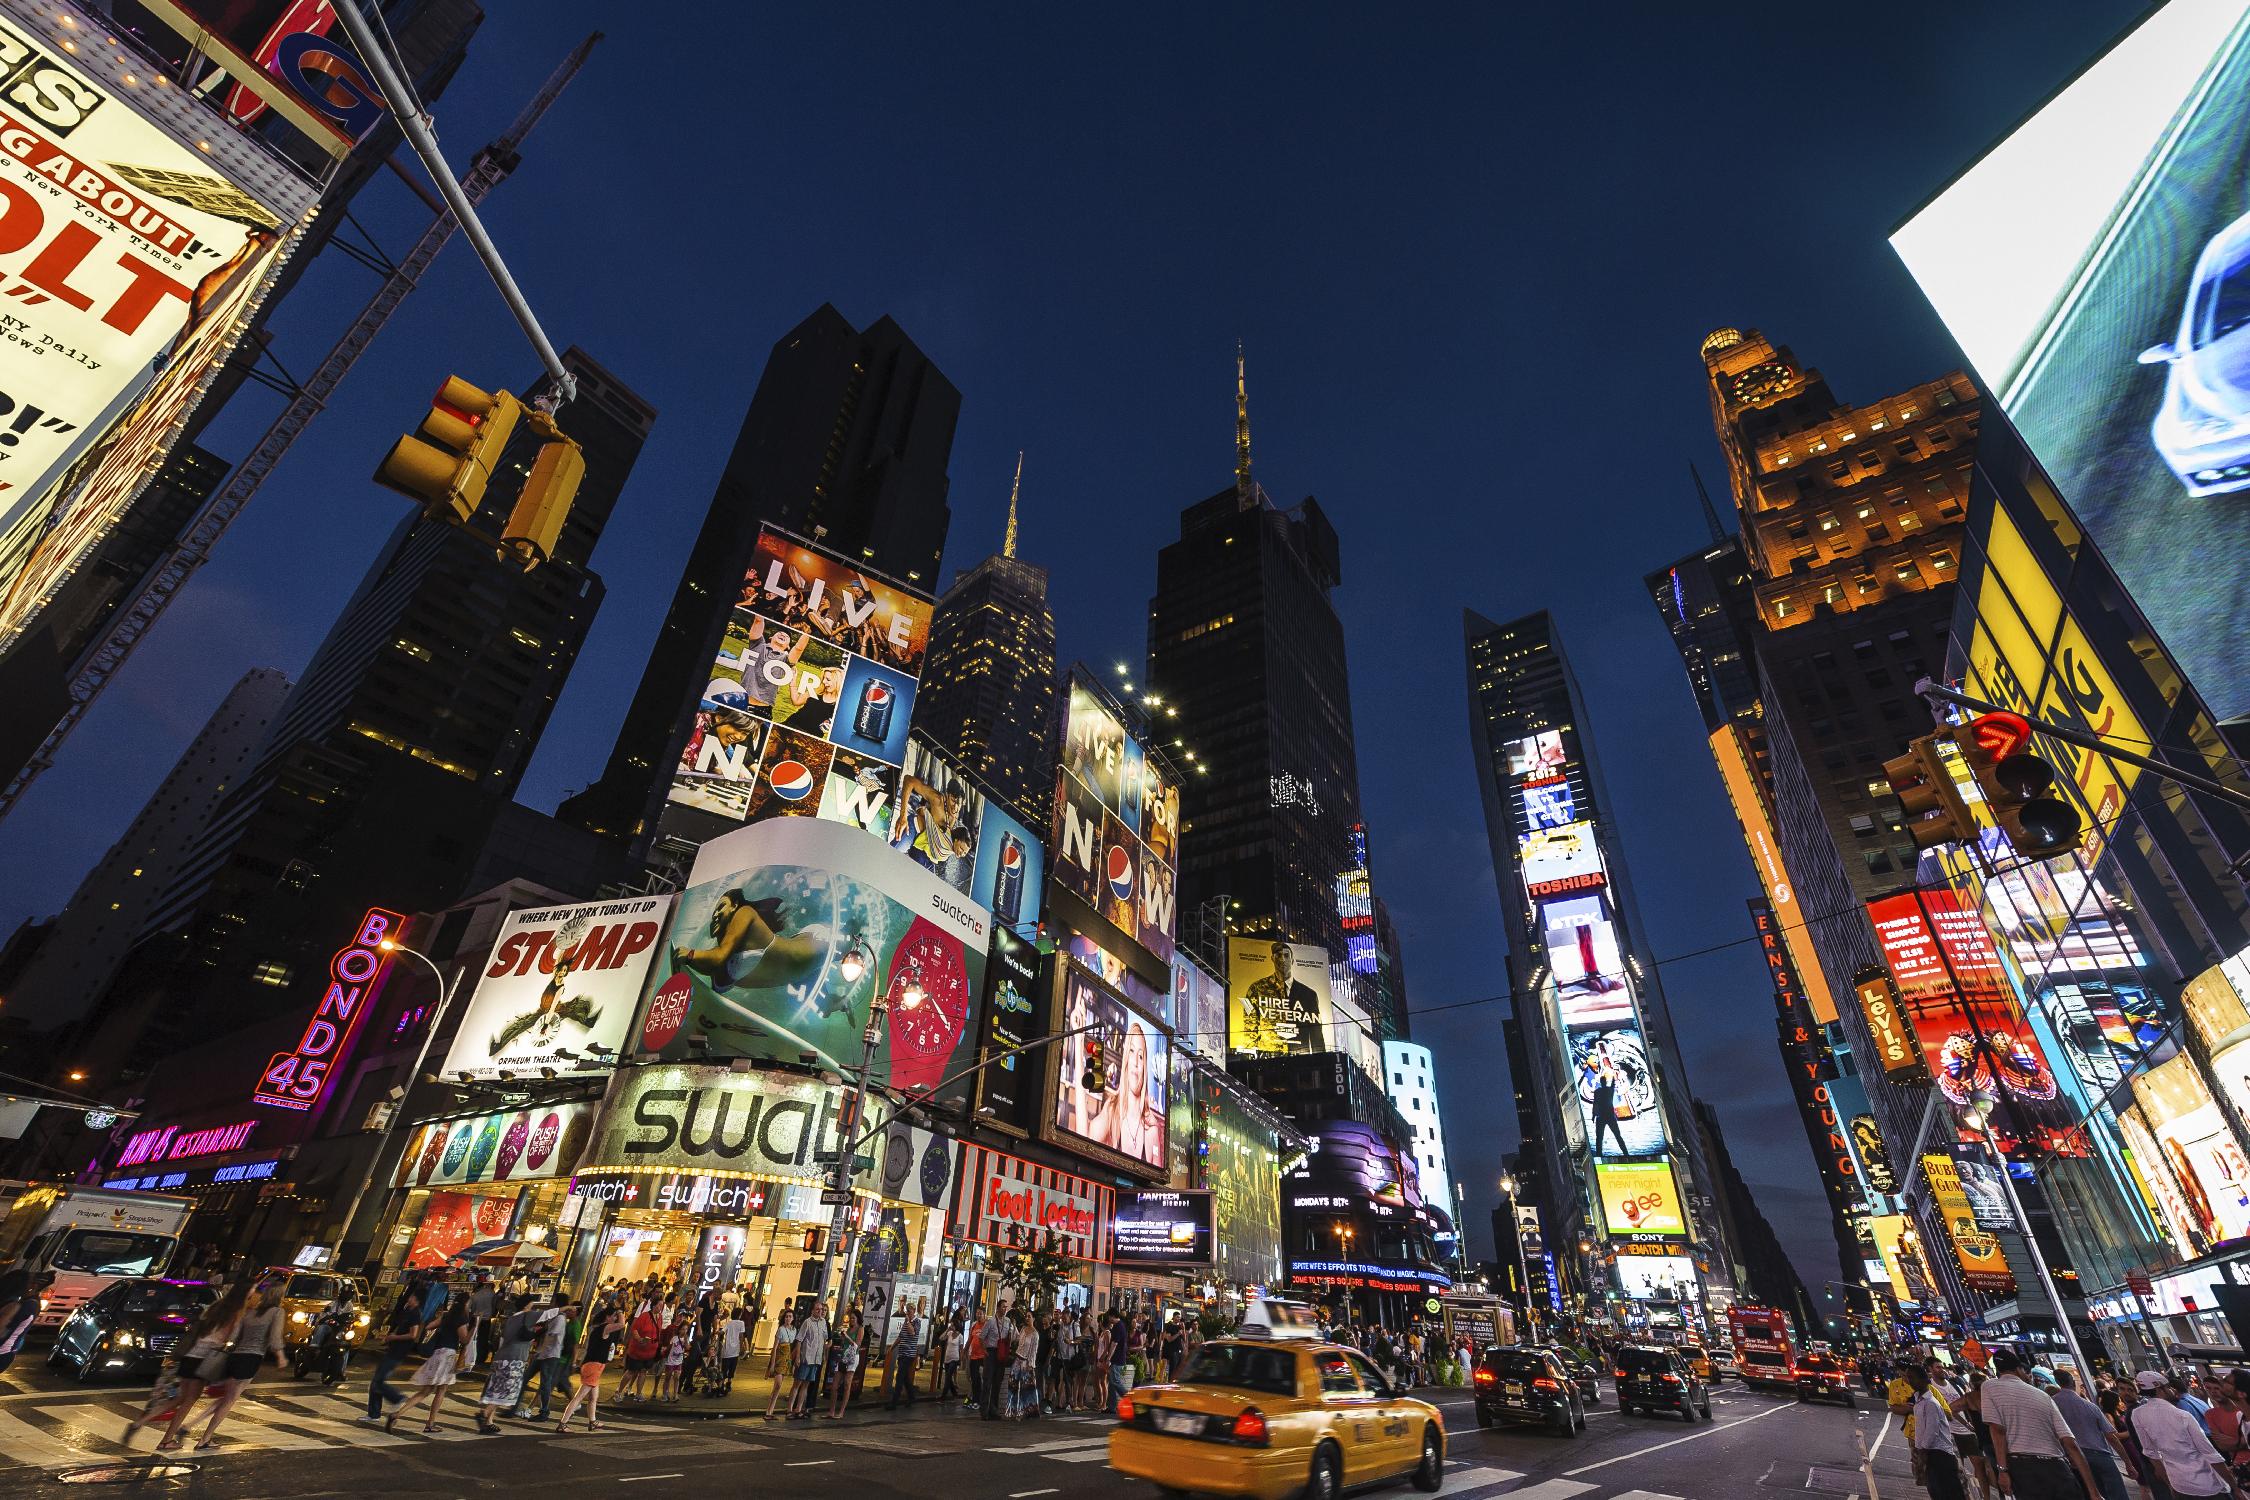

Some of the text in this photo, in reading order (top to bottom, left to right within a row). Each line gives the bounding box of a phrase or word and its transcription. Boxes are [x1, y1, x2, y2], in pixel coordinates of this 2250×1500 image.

[23, 171, 183, 271] New York Times
[1, 314, 102, 371] NY Daily
[764, 560, 914, 649] LIVE
[737, 648, 820, 701] FOR
[1074, 722, 1116, 776] LIVE
[1522, 774, 1567, 790] TOSHIBA
[1527, 766, 1558, 782] 2012
[1145, 788, 1177, 840] FOR
[2080, 849, 2091, 866] ON
[2097, 796, 2114, 825] STREET
[1529, 872, 1604, 896] TOSHIBA
[519, 901, 657, 924] WHERE NEW YORK TURNS IT UP
[932, 894, 976, 932] swatch
[1560, 911, 1599, 928] TDK
[1885, 935, 1930, 950] NOTHING
[1886, 926, 1920, 939] SIMPLY
[486, 921, 659, 978] STOMP
[299, 914, 389, 1057] BOND
[652, 989, 689, 1012] PUSH
[1258, 996, 1304, 1011] HIRE A
[646, 1015, 681, 1032] OF FUN
[650, 1007, 684, 1019] THE BUTTON
[1258, 1007, 1321, 1024] VETERAN
[1756, 916, 1854, 1175] ERNST & YOUNG
[498, 1055, 531, 1065] ORPHEUM
[266, 1057, 329, 1098] 45
[1334, 1053, 1345, 1095] 1500
[168, 1120, 257, 1160] RESTAURANT
[534, 1127, 558, 1141] PUSH
[658, 1184, 747, 1208] swatch
[1609, 1178, 1661, 1191] new night
[838, 1194, 849, 1202] WAY
[987, 1176, 1095, 1236] Foot Locker
[1295, 1198, 1329, 1207] MONDAYS
[1631, 1233, 1664, 1241] SONY
[1359, 1264, 1366, 1272] TO
[1966, 1272, 2010, 1281] RESTAURANT
[1395, 1284, 1420, 1292] SQUARE
